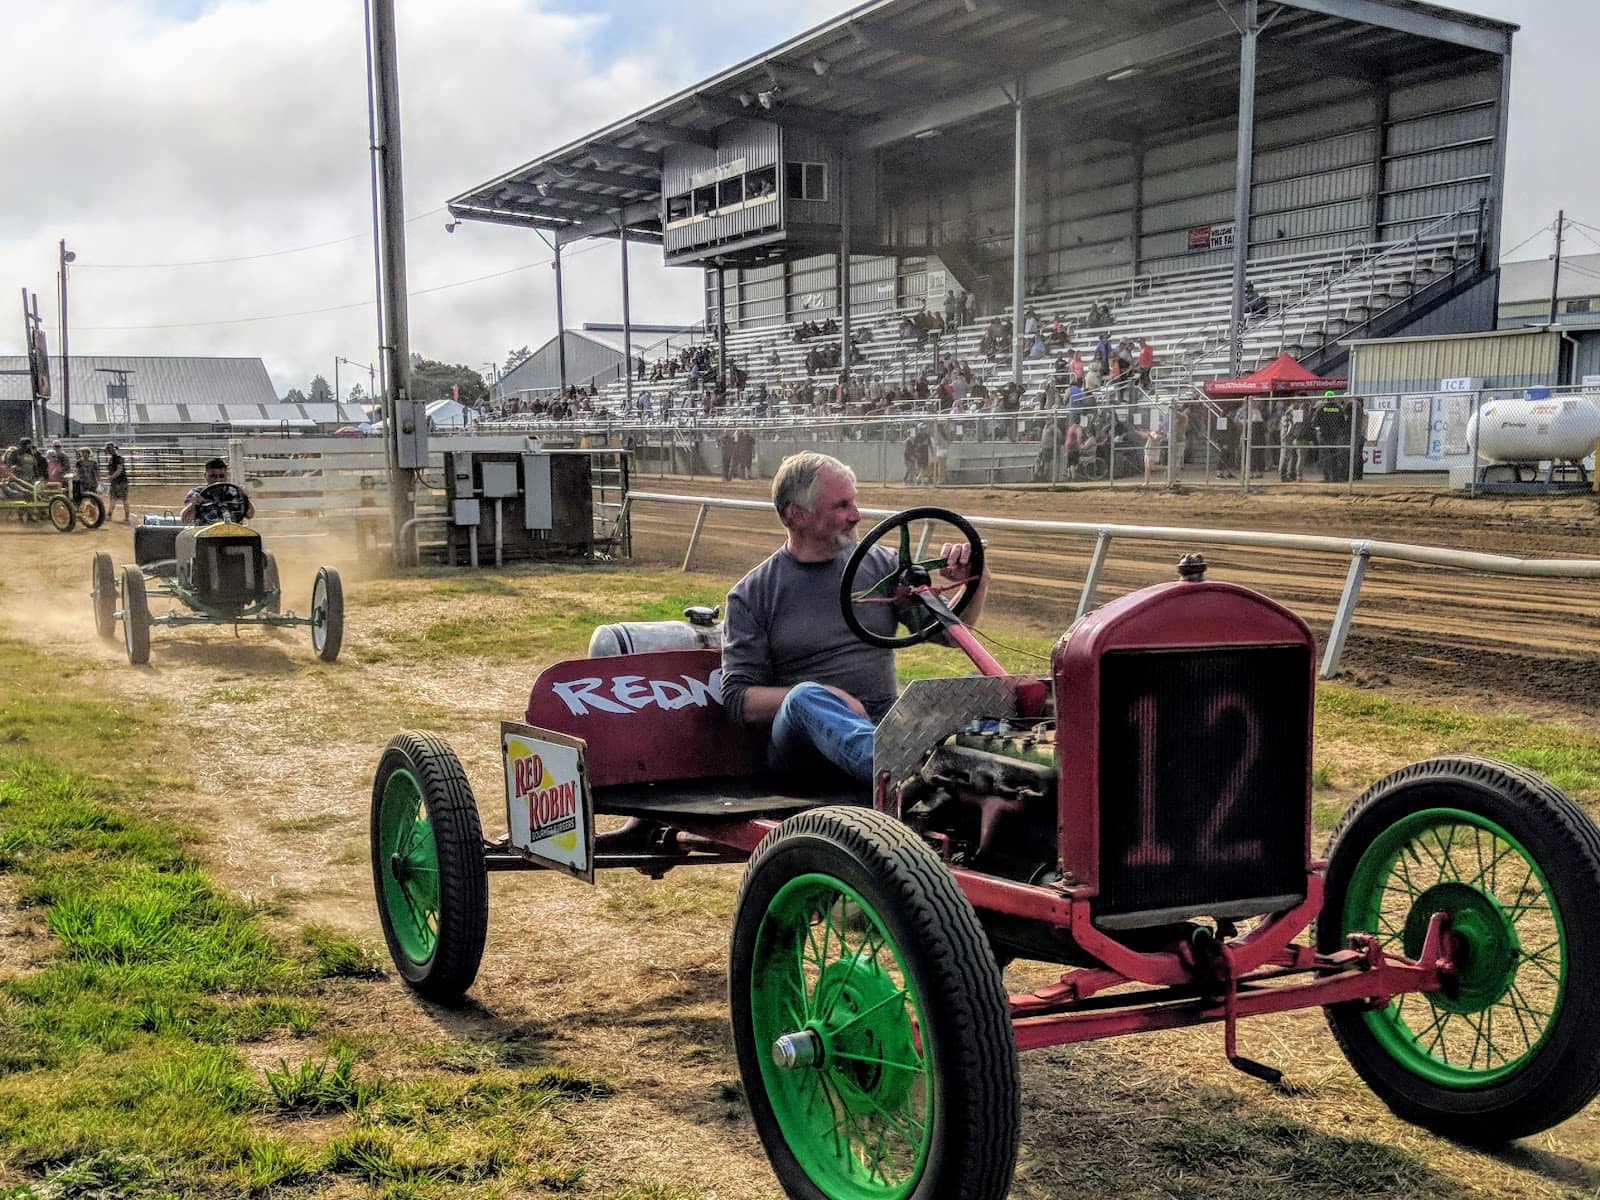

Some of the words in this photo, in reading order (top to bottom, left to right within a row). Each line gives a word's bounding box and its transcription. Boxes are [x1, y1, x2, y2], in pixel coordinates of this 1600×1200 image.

[1211, 236, 1222, 247] THE
[1445, 380, 1465, 390] ICE
[1378, 401, 1392, 409] ICE
[1360, 449, 1382, 465] CE
[552, 668, 725, 716] REDN
[514, 754, 543, 798] RED
[1125, 689, 1263, 865] 12
[528, 780, 576, 830] ROBIN
